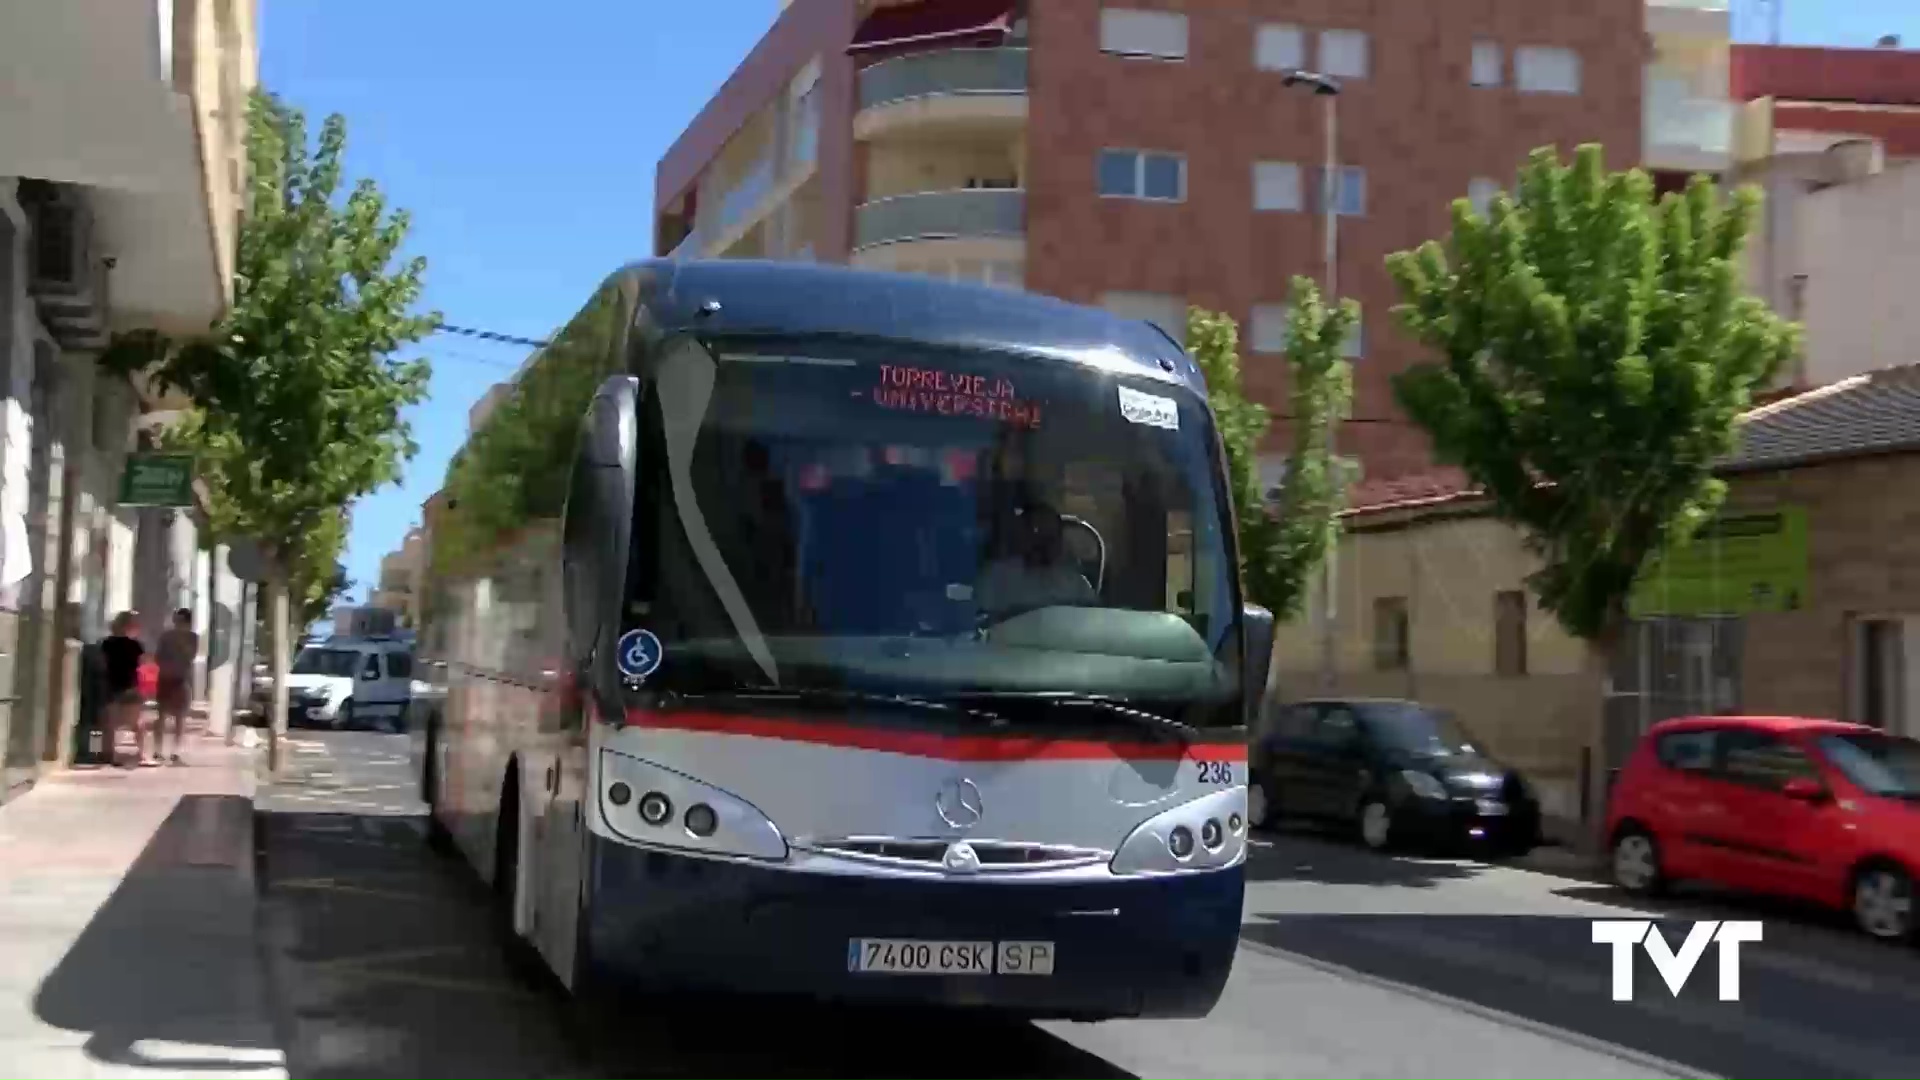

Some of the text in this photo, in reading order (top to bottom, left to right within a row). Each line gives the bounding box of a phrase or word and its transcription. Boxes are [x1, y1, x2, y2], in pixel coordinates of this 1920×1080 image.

[1196, 761, 1232, 785] 236
[866, 943, 985, 970] 7400 CSK
